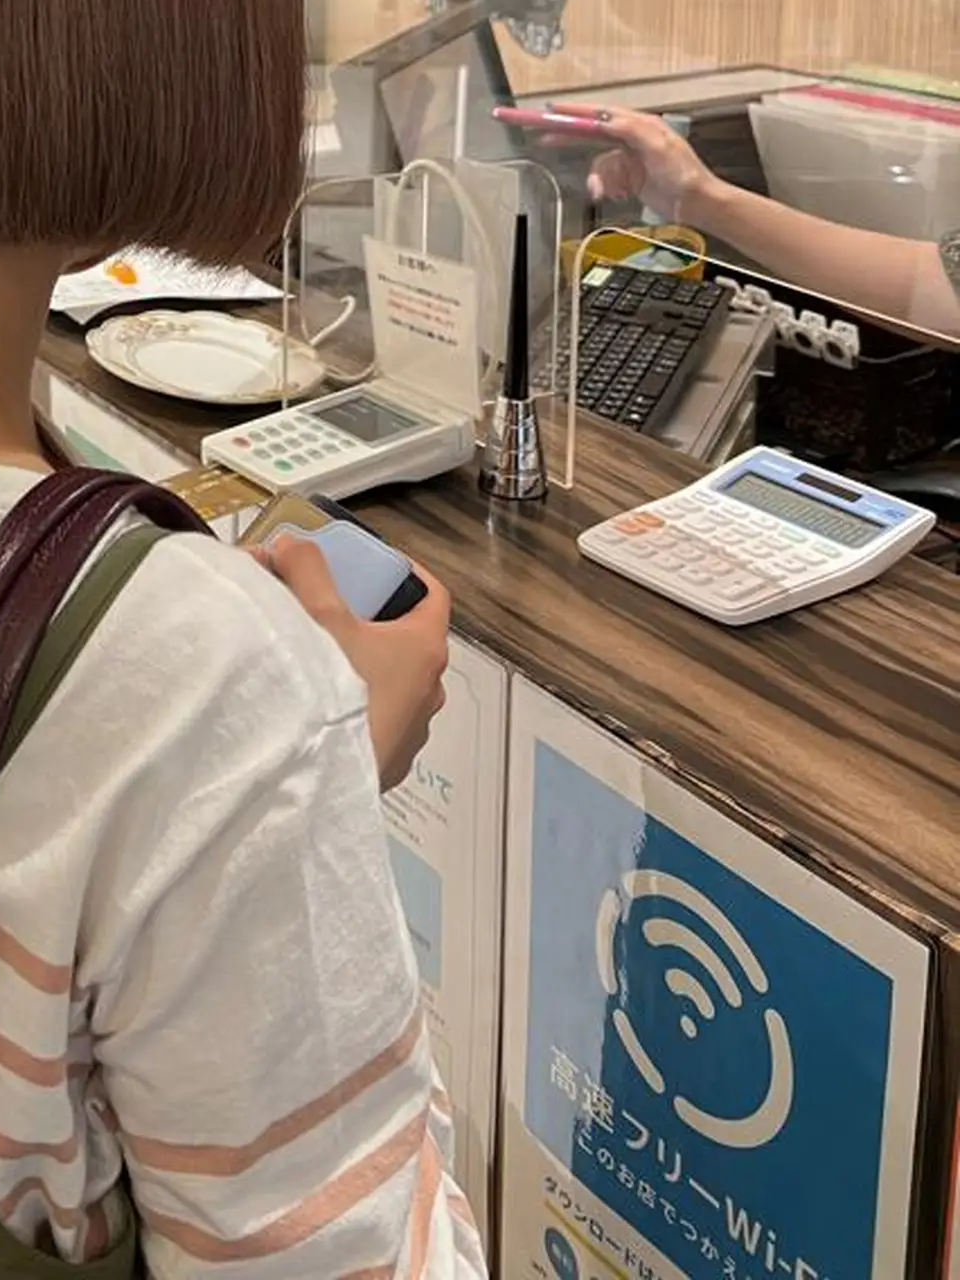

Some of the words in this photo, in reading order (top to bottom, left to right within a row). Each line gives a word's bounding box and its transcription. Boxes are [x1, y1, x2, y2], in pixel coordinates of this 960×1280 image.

[416, 760, 454, 808] いて
[544, 1176, 666, 1280] ダウンロードは
[551, 1045, 830, 1280] 高速フリーWi-F
[578, 1118, 751, 1280] このお店でつかえ
